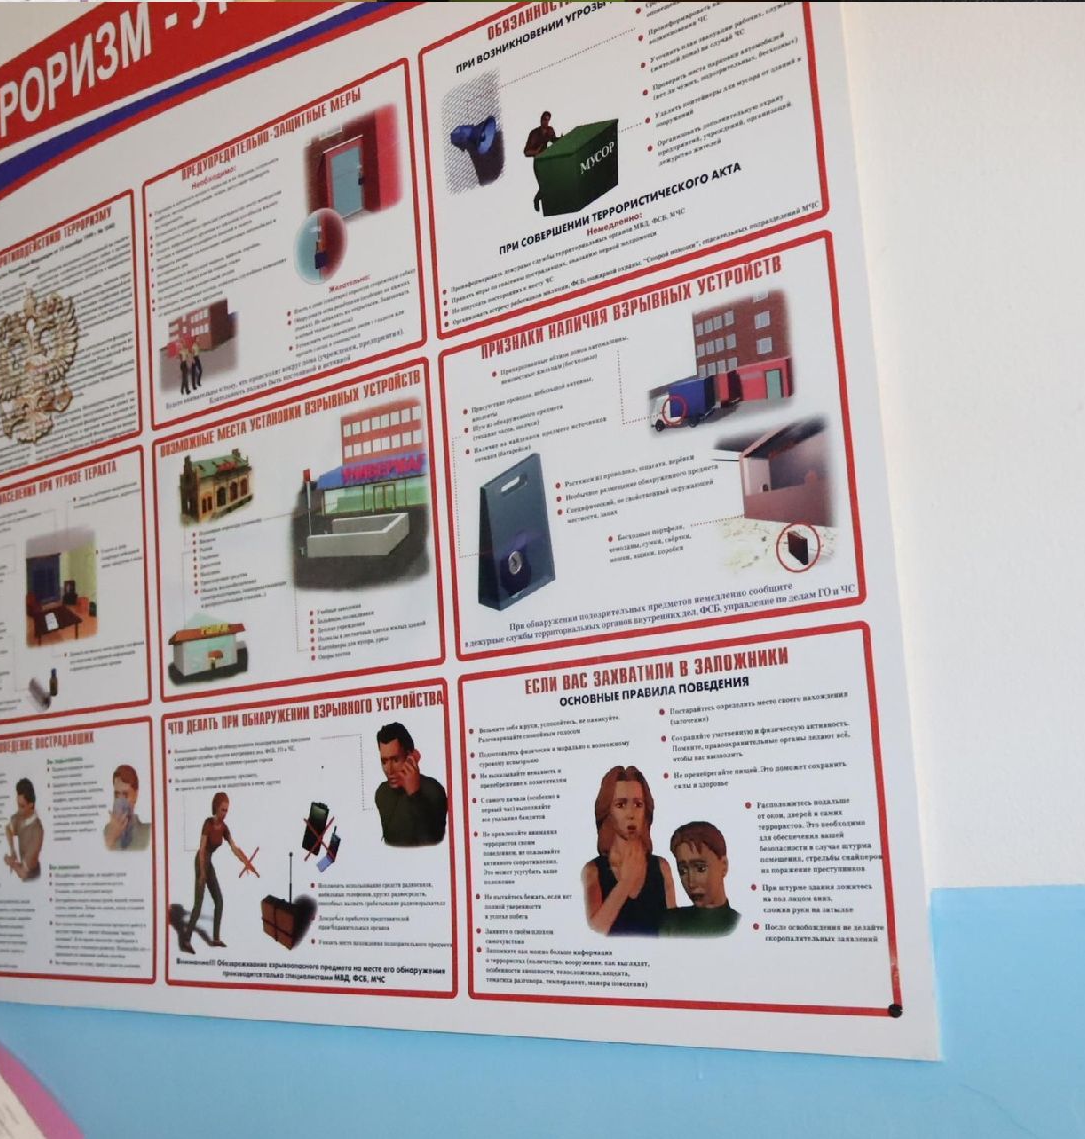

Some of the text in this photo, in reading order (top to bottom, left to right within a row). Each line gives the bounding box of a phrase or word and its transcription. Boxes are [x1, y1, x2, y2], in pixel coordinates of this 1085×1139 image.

[456, 2, 605, 73] ПРИ ВОЗНИКНОВЕНИИ УГРОЗЫ
[330, 88, 361, 113] МЕРЫ
[578, 139, 616, 175] МУСОР
[500, 163, 741, 255] ПРИ СОВЕРШЕНИИ ТЕРРОРИСТИЧЕСКОГО АКТА
[480, 256, 781, 359] ПРИЗНАКИ НАЛИЧИЯ ВЗРЫВНЫХ УСТРОЙСТВ
[160, 370, 420, 458] ВОЗМОЖНЫЕ МЕСТА УСТАНОВКИ ВЗРЫВНЫХ УСТРОЙСТВ
[468, 637, 505, 647] дежурные
[506, 631, 533, 642] службы
[534, 624, 600, 639] территориальных
[601, 619, 633, 629] органов
[634, 611, 681, 624] внутренних
[724, 598, 774, 613] управление
[788, 592, 816, 603] делам
[818, 587, 831, 597] ГО
[840, 584, 856, 599] ЧС
[509, 623, 525, 632] При
[579, 606, 646, 621] подозрительных
[648, 599, 692, 612] предметов
[694, 590, 746, 605] немедленно
[749, 584, 792, 596] сообщите
[525, 677, 557, 694] ЕСЛИ
[563, 672, 587, 690] ВАС
[593, 662, 674, 687] ЗАХВАТИЛИ
[680, 661, 688, 677] В
[560, 677, 749, 707] ОСНОВНЫЕ ПРАВИЛА ПОВЕДЕНИЯ
[167, 689, 444, 735] ЧТО ДЕЛАТЬ ПРИ ОБНАРУЖЕНИИ ВЗРЫВНОГО УСТРОЙСТВА
